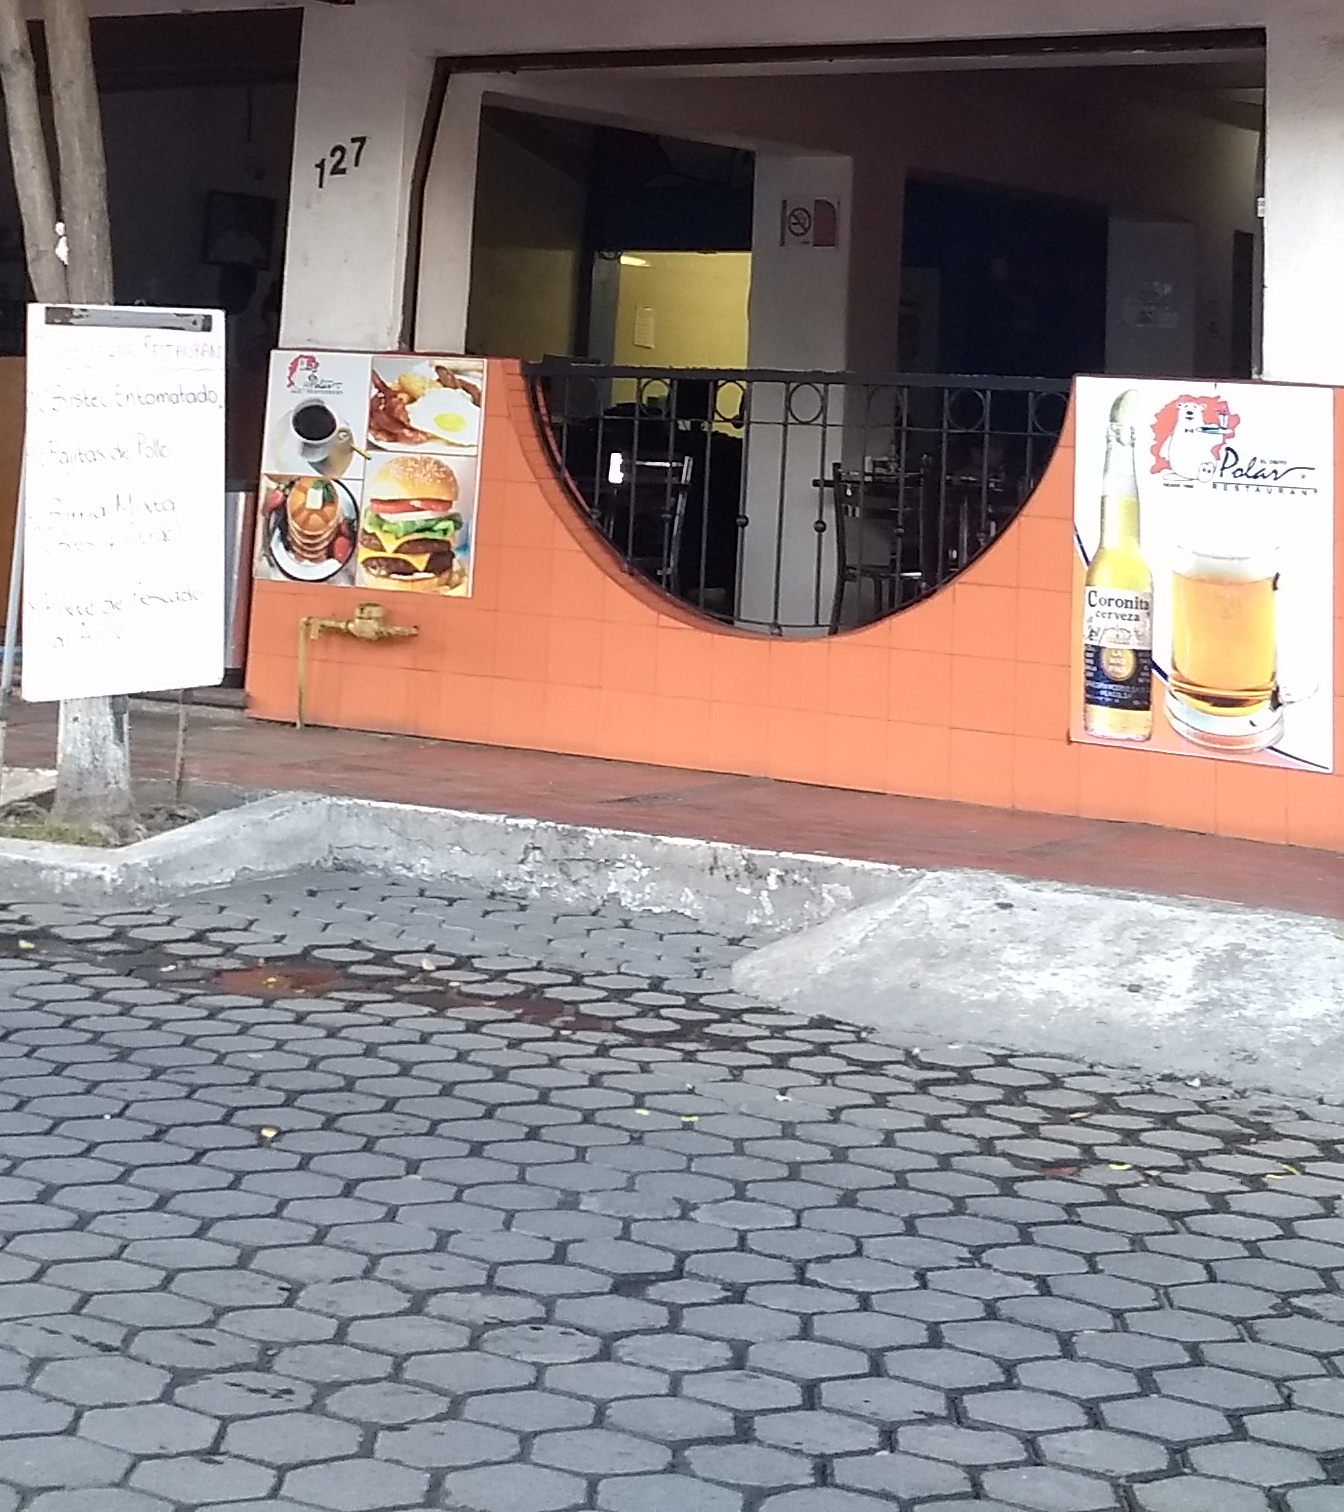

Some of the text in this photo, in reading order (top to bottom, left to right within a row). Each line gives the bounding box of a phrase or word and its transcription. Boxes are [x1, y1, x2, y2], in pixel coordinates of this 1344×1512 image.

[315, 136, 368, 188] 127
[1220, 446, 1315, 482] Polar
[1088, 589, 1150, 610] Coronita
[1095, 610, 1140, 622] cerveza
